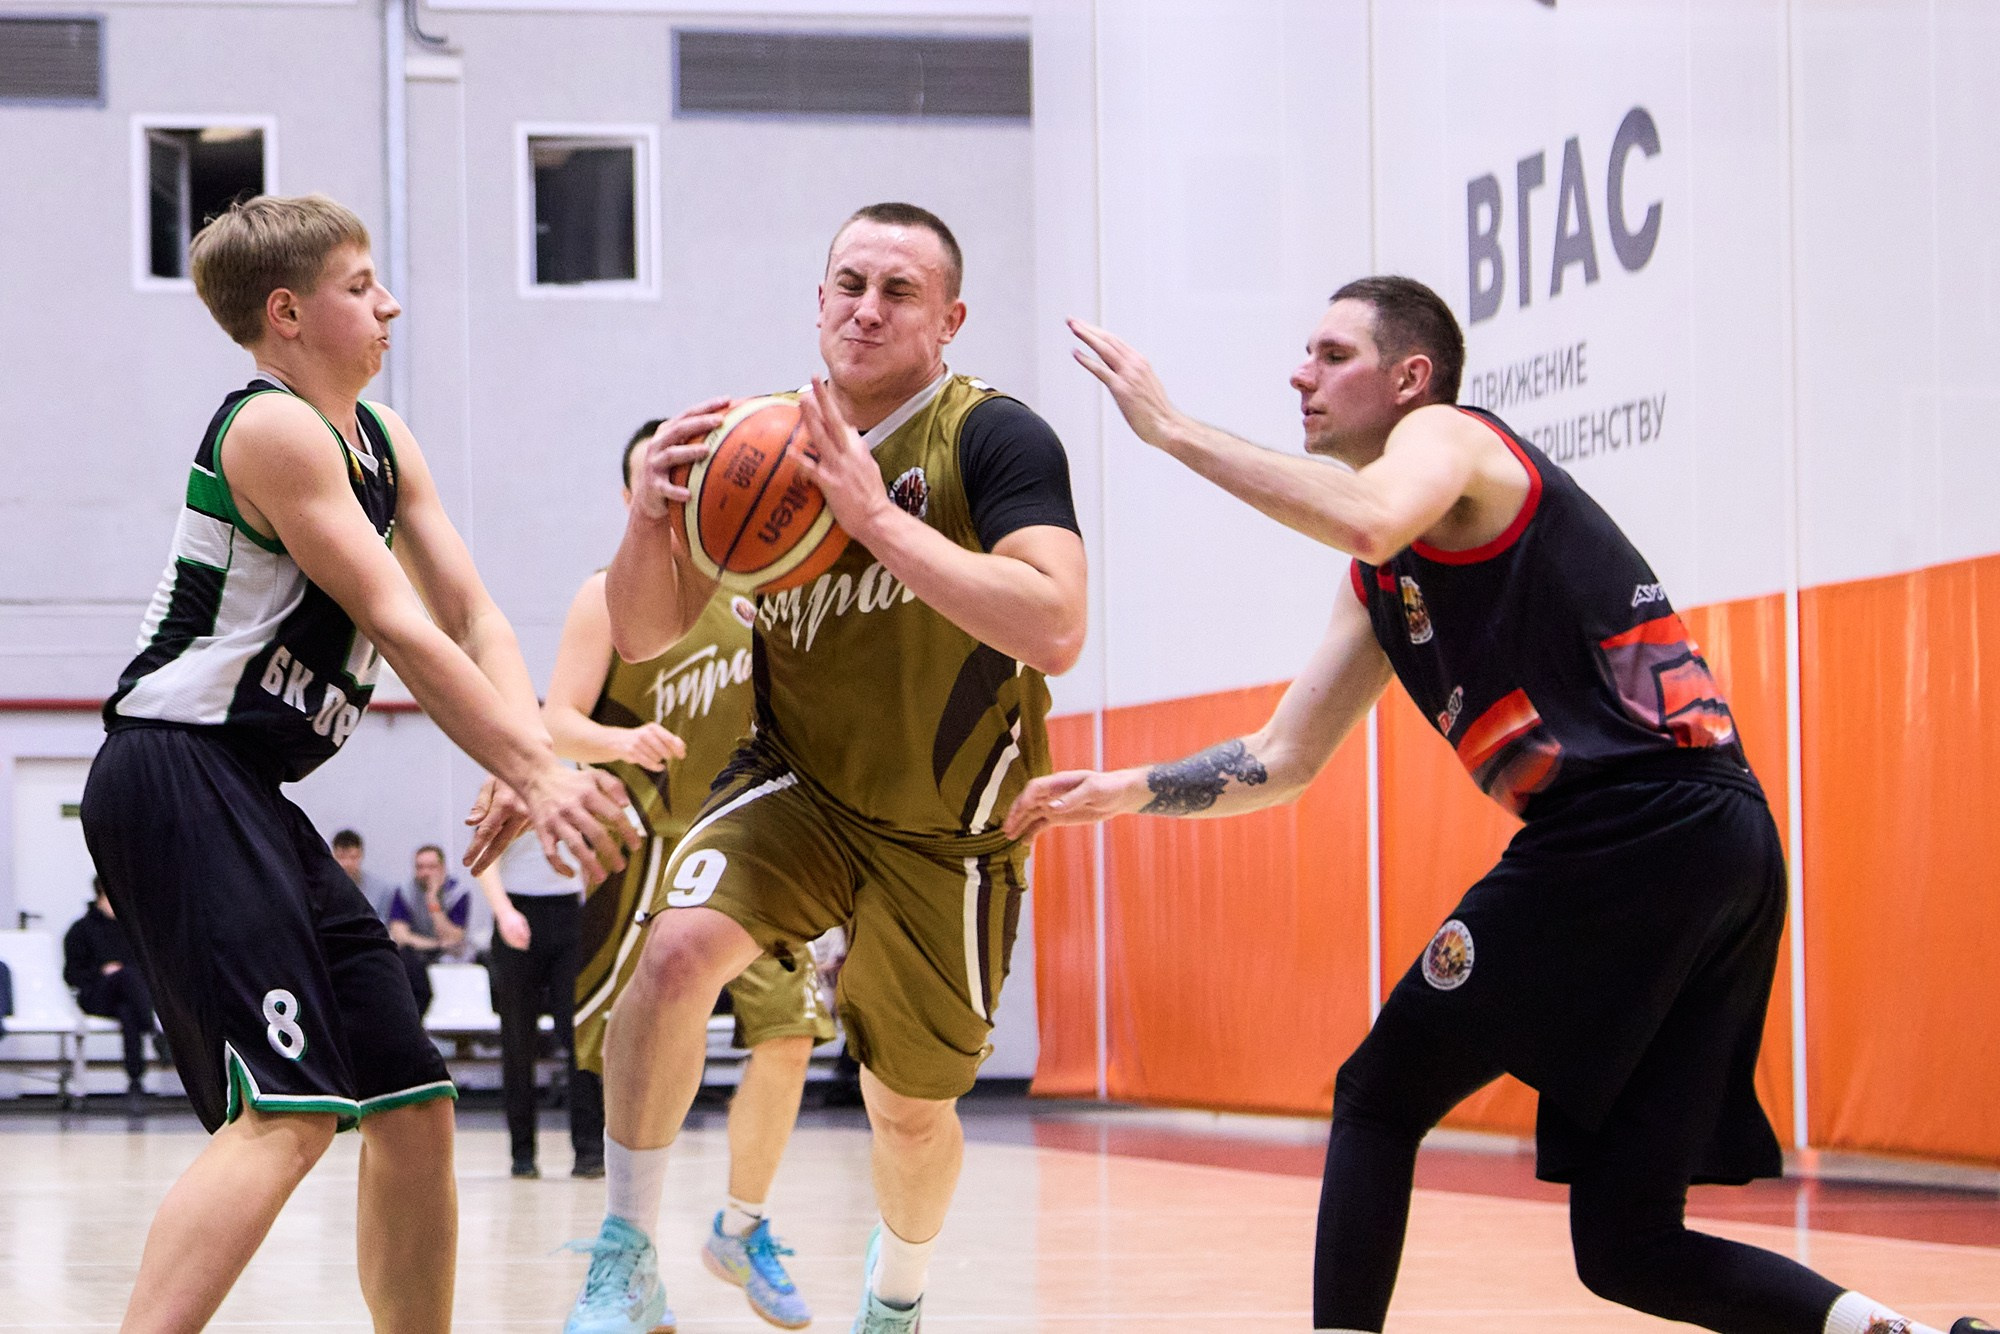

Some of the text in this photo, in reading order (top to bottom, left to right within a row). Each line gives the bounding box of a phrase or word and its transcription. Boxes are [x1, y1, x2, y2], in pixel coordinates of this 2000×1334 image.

[1466, 106, 1663, 326] ВГАС
[1522, 391, 1667, 463] РШЕНСТВУ
[259, 644, 315, 715] БК
[666, 848, 728, 908] 9
[262, 988, 307, 1061] 8
